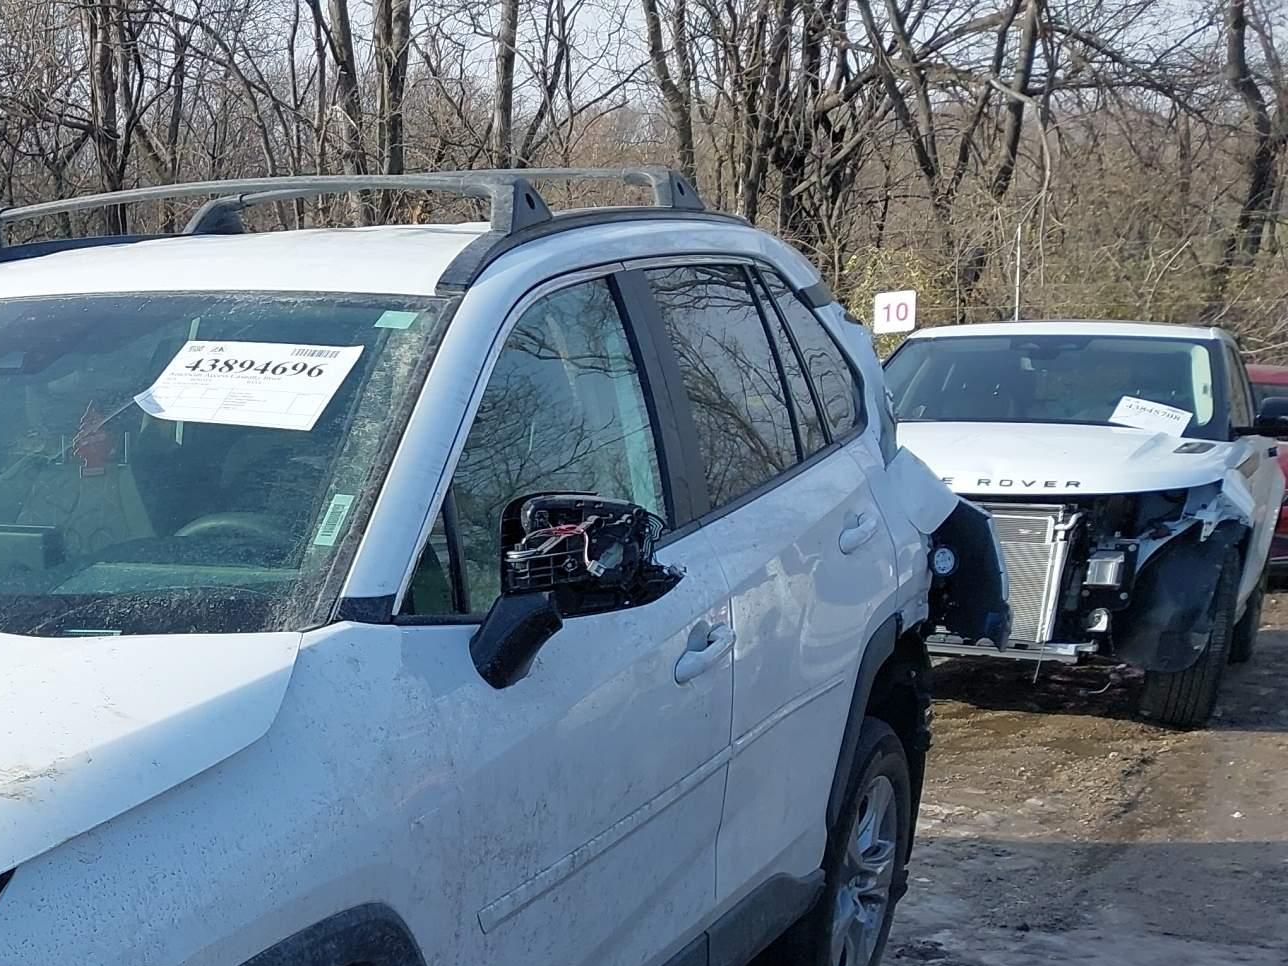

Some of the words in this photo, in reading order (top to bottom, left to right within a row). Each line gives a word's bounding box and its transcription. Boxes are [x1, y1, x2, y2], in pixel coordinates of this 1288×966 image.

[883, 302, 908, 322] 10
[185, 357, 329, 378] 43894696
[977, 478, 1081, 488] ROVER
